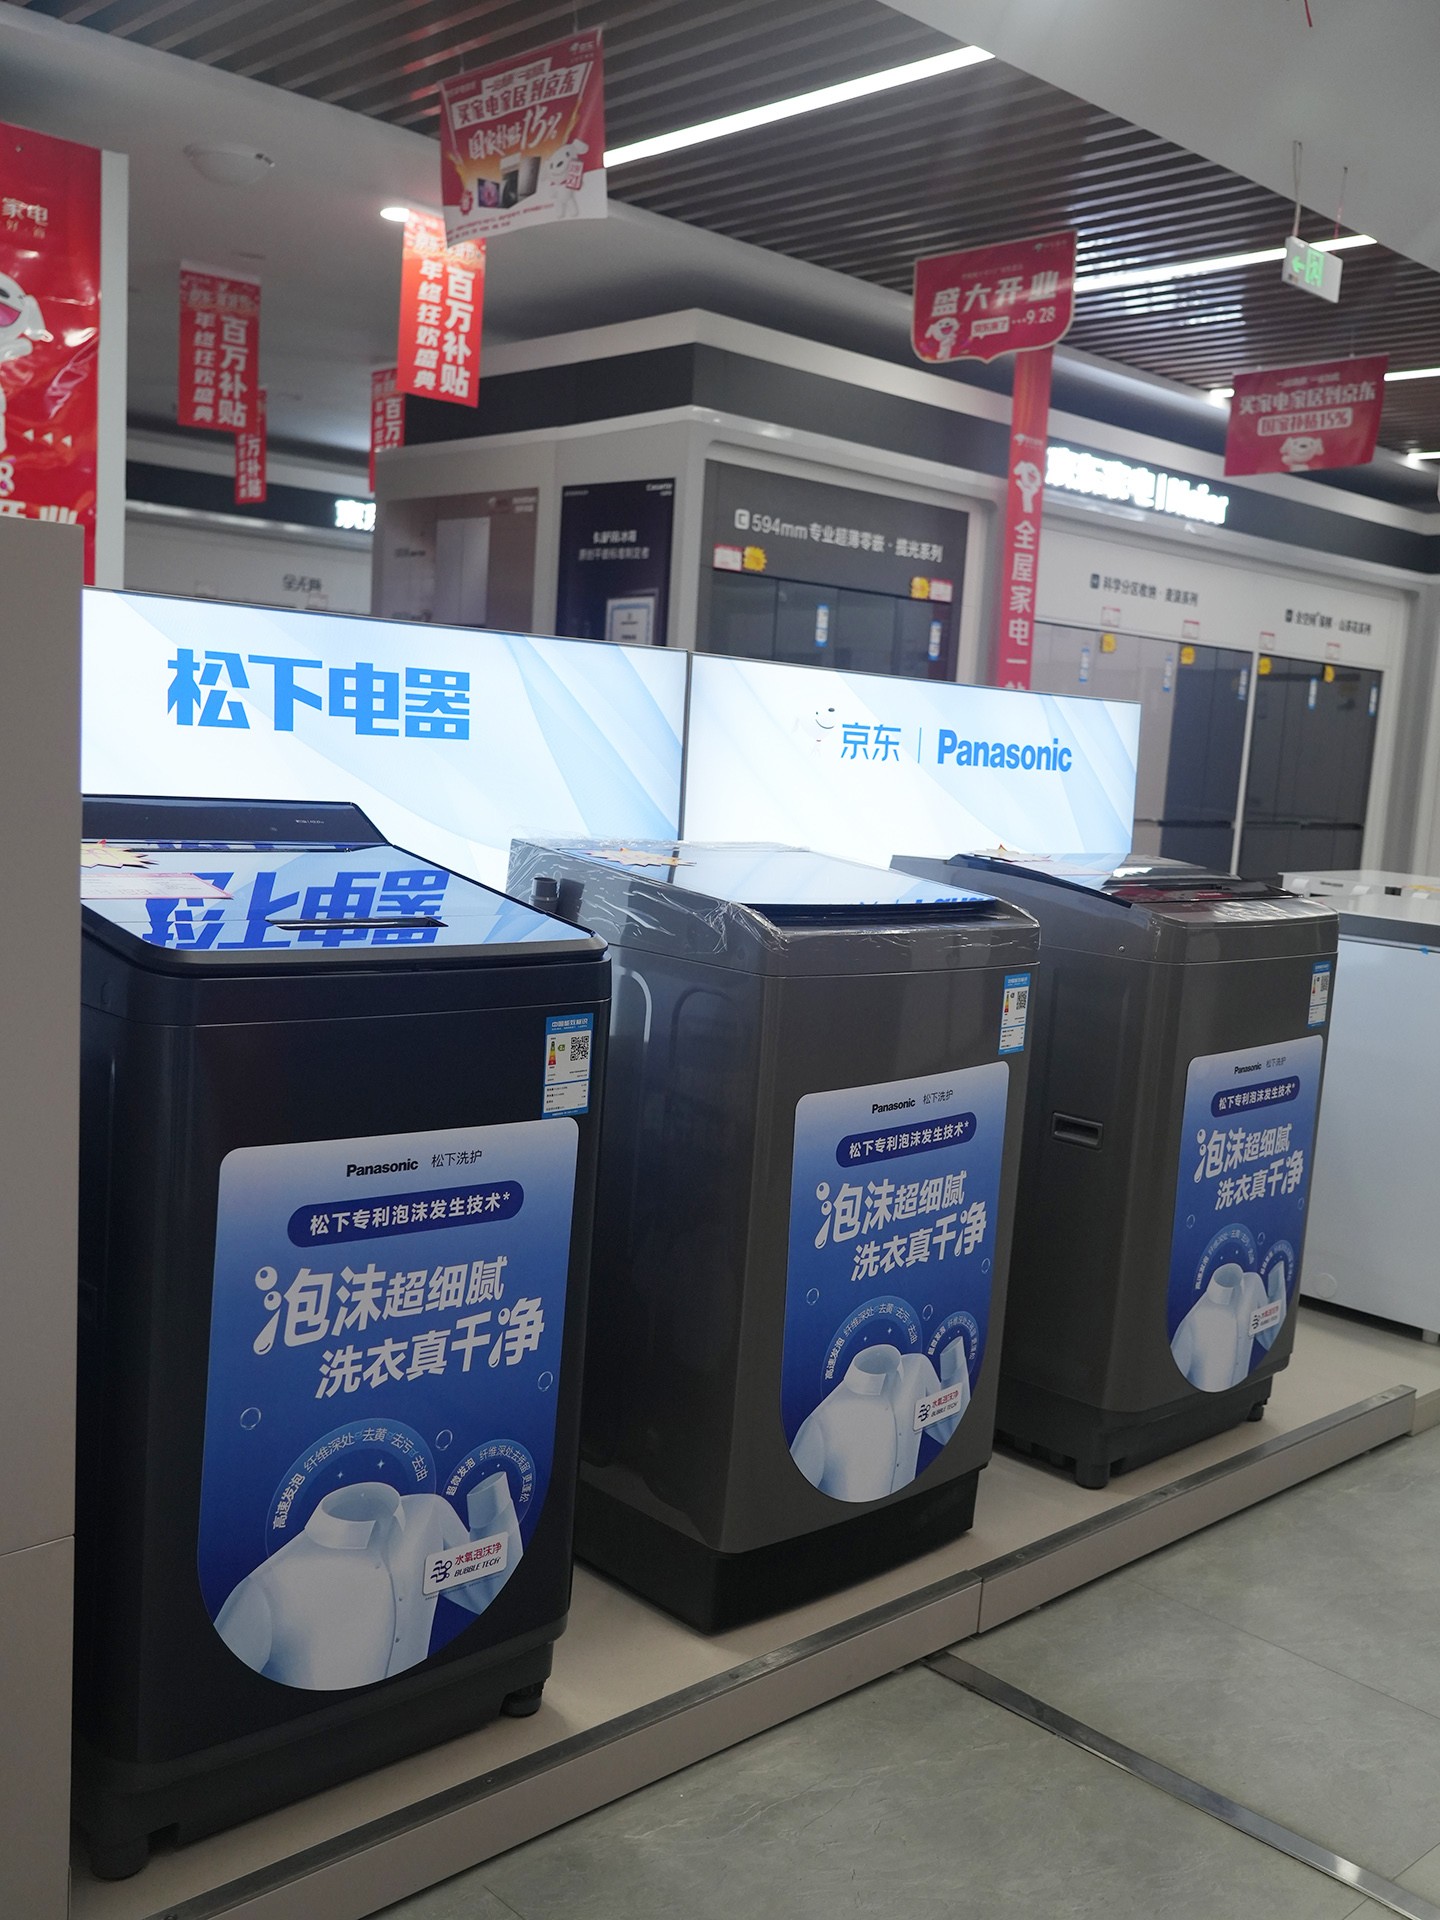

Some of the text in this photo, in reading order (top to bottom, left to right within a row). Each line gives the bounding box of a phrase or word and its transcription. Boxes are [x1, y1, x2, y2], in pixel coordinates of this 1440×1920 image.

[931, 270, 1059, 317] 盛大开业
[440, 266, 475, 398] 百万补贴
[218, 315, 248, 427] 百万补贴
[1239, 381, 1377, 415] 买家电家居到京东
[384, 397, 403, 449] 百万
[167, 648, 469, 740] 松下电器
[841, 722, 1072, 772] 京东 Panasonic
[1234, 1062, 1262, 1074] Panasonic
[872, 1089, 954, 1114] Panasonic 松下洗护
[346, 1149, 483, 1177] Panasonic 松下洗护
[1194, 1123, 1292, 1183] 泡沫超细腻
[1215, 1150, 1304, 1211] 洗衣真干净
[815, 1170, 967, 1249] 泡沫超细腻
[851, 1201, 987, 1282] 洗衣真干净
[252, 1256, 508, 1356] 泡沫超细腻
[314, 1297, 546, 1400] 洗衣真干净
[273, 1427, 429, 1530] 高速发泡 纤维深处 去黄 去污 去油
[454, 1556, 501, 1577] BUBBLE TECH
